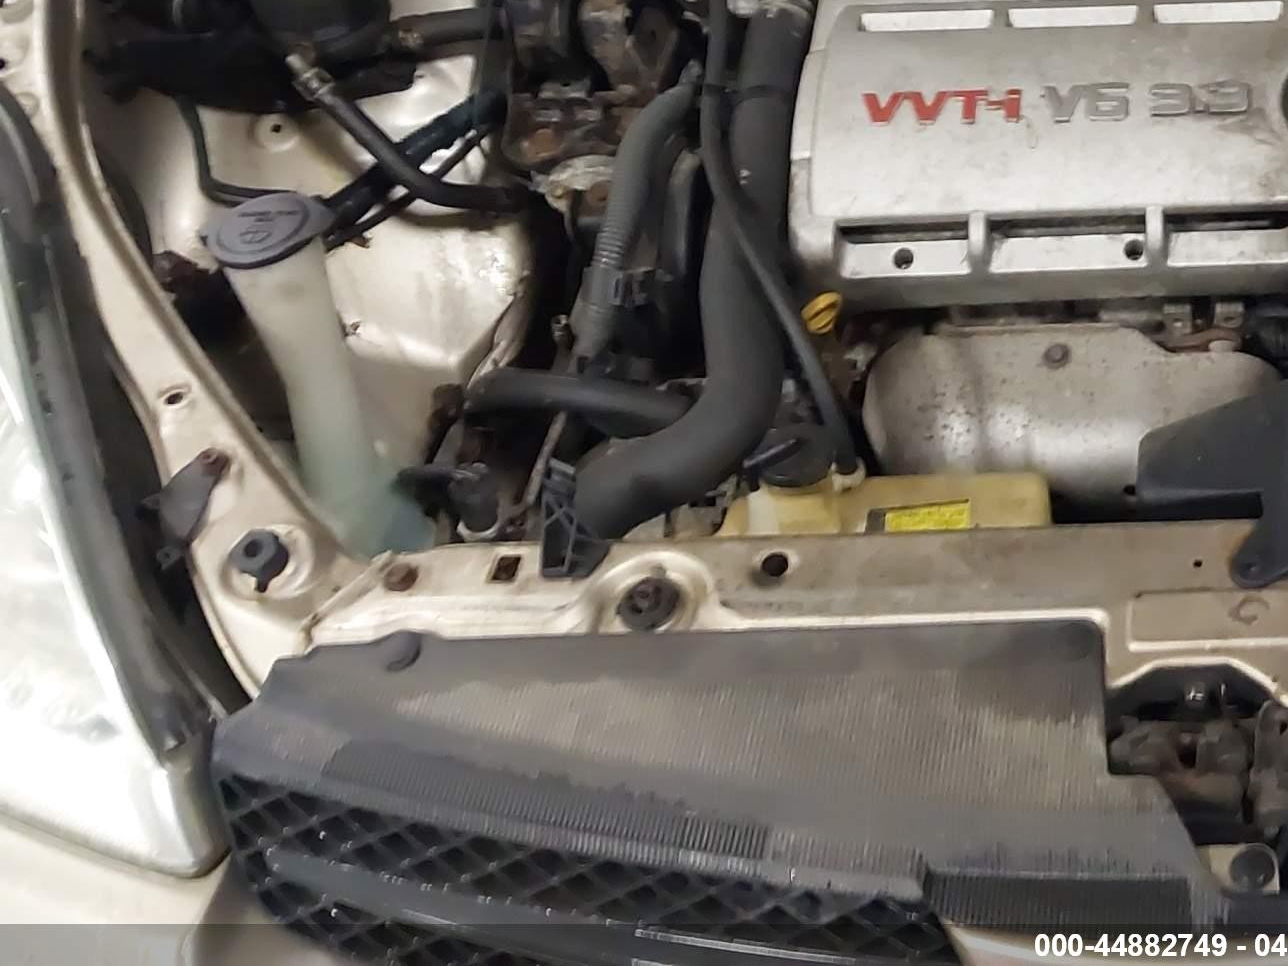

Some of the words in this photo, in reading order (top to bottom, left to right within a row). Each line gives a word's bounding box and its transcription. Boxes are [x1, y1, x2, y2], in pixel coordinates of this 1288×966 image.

[862, 88, 1023, 125] VVT-i
[1040, 81, 1130, 124] V6
[1150, 79, 1253, 118] 3.3
